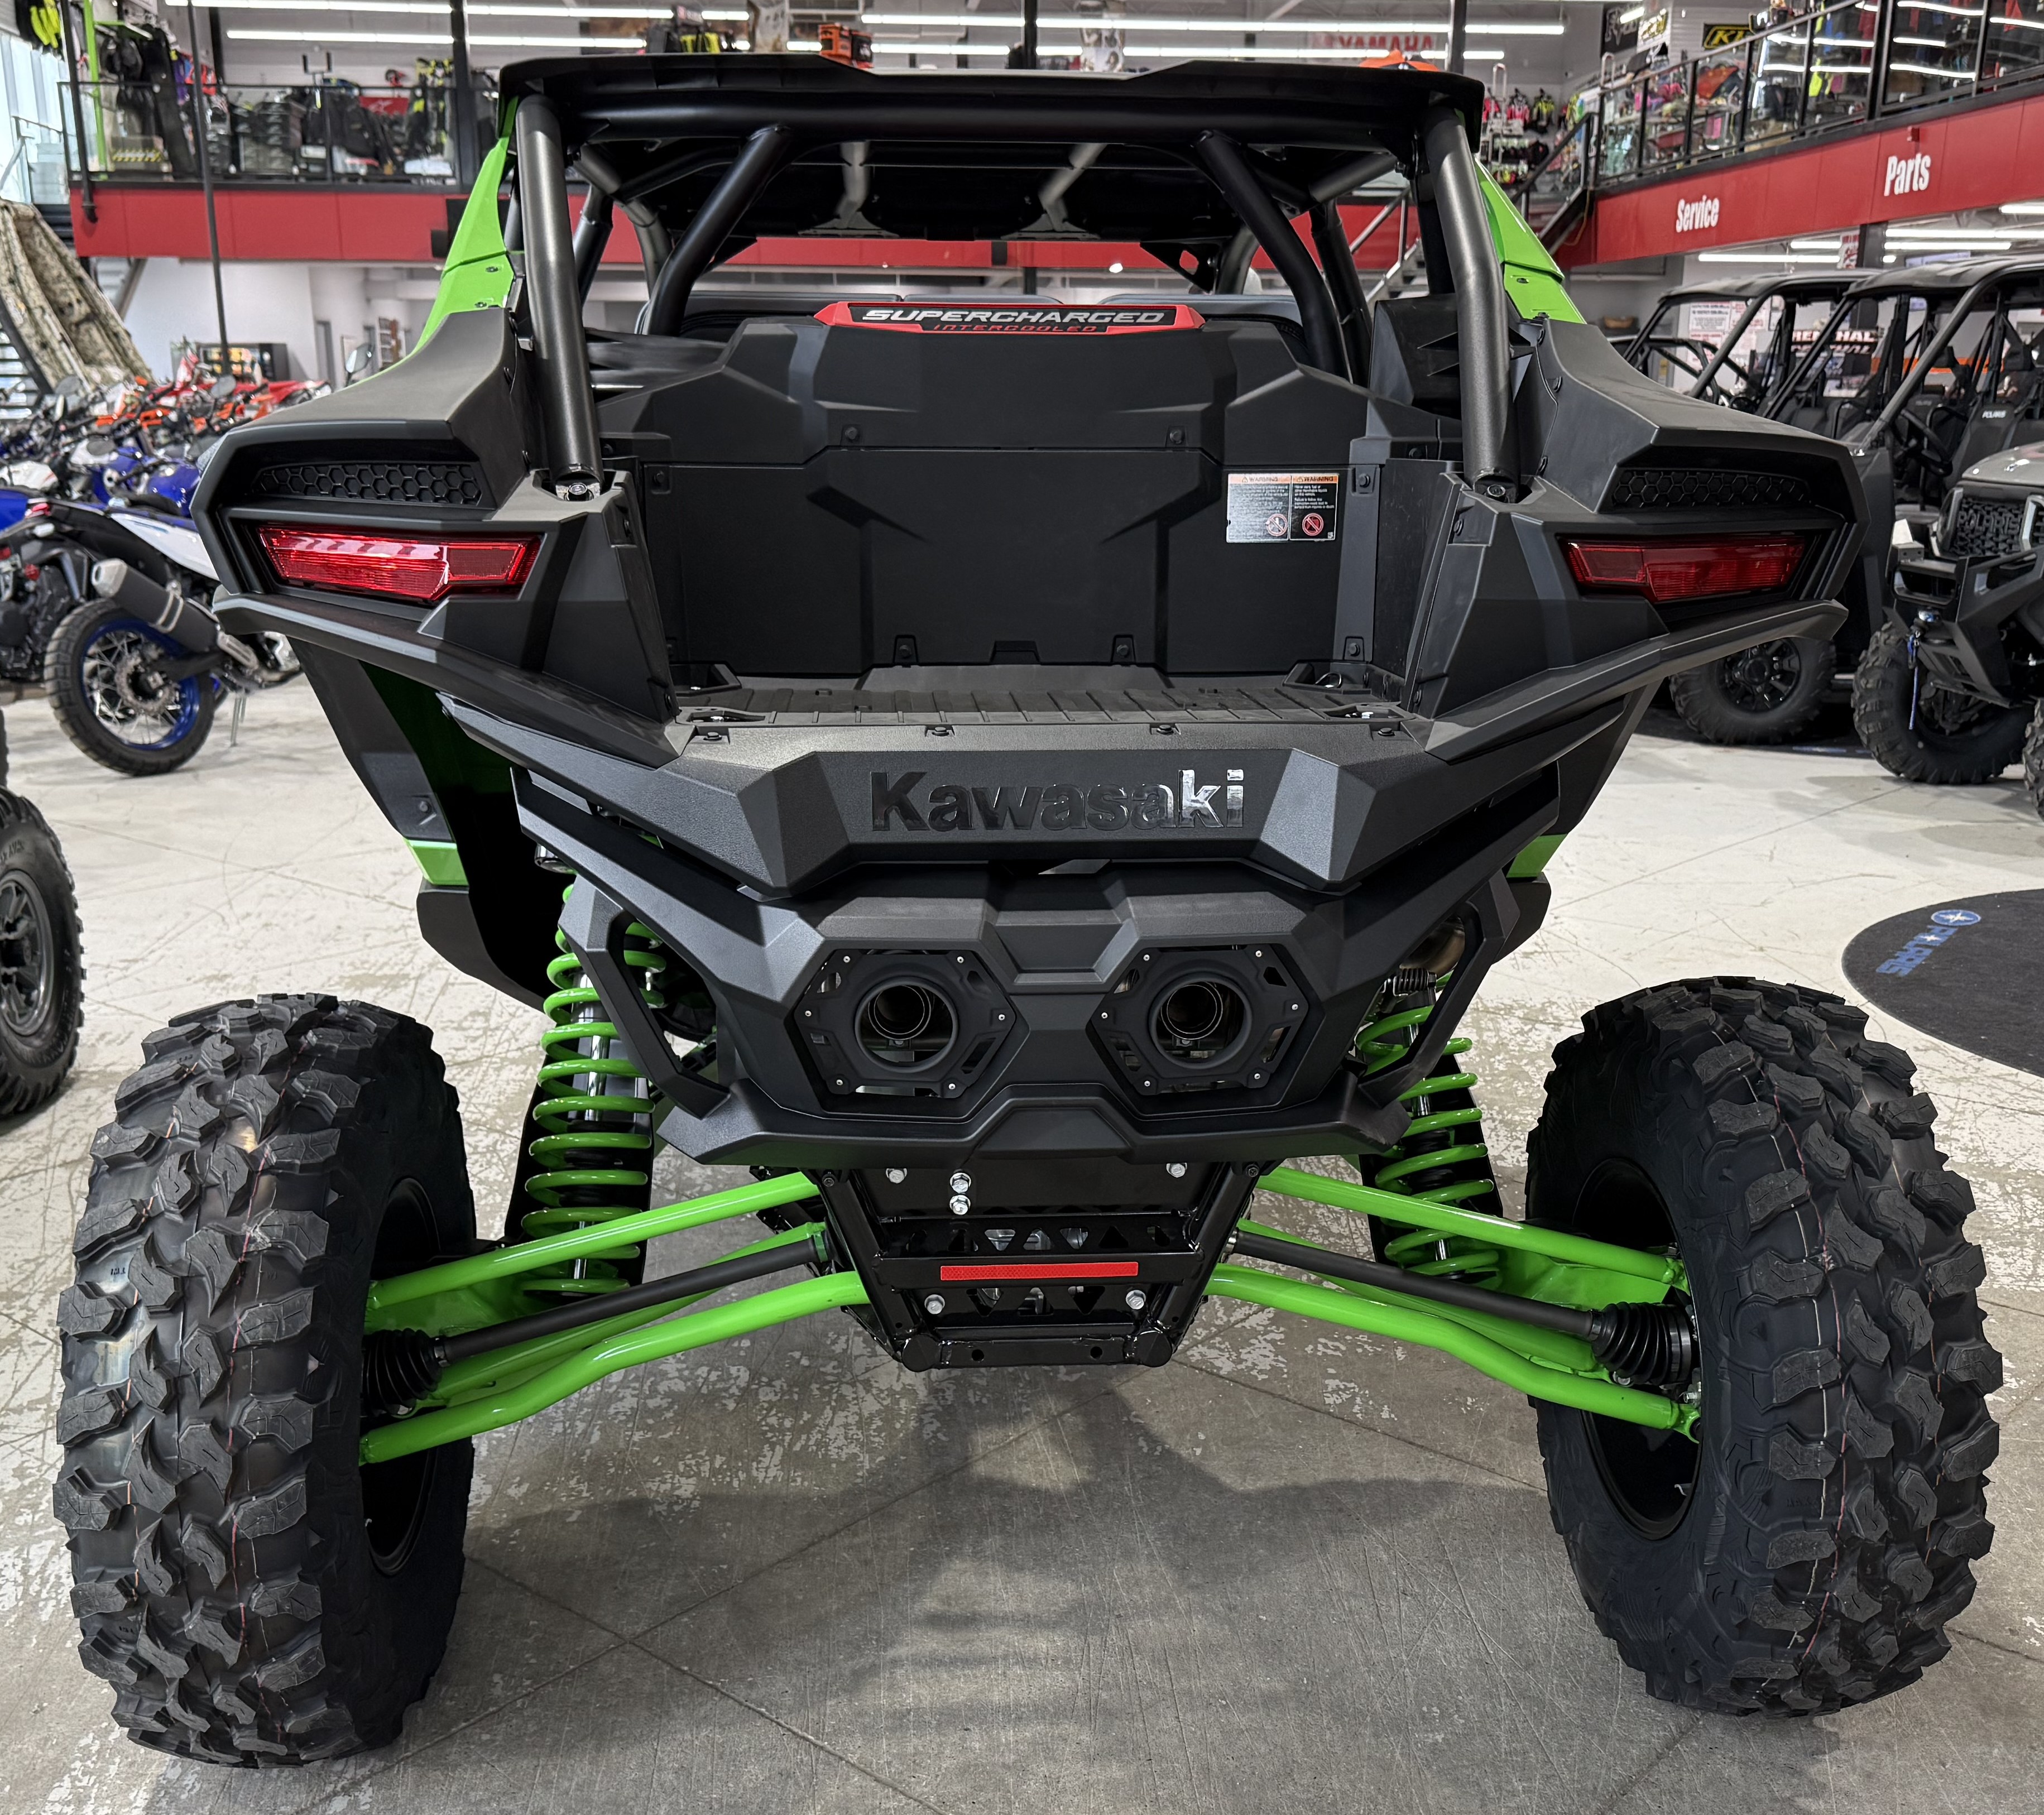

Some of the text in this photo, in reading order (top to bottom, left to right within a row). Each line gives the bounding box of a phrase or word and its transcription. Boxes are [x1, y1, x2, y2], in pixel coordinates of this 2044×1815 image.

[1883, 152, 1931, 197] Parts
[1676, 194, 1720, 233] Service
[862, 310, 1164, 323] SUPERCHARGED
[871, 769, 1244, 832] Kawasaki
[1875, 924, 1961, 977] POLARIS
